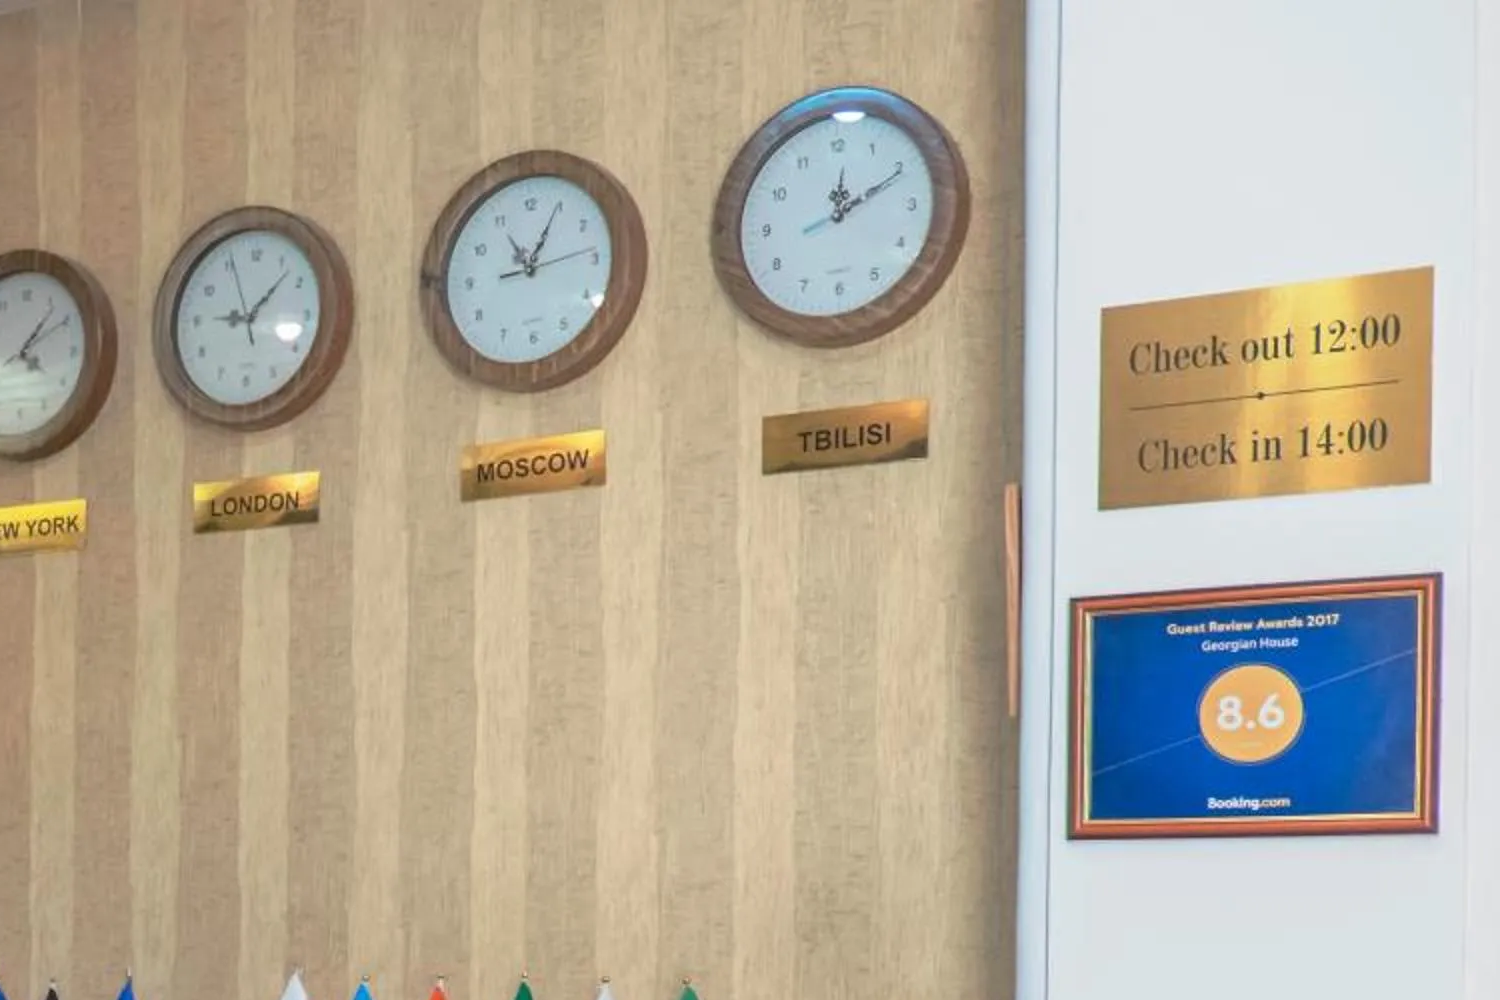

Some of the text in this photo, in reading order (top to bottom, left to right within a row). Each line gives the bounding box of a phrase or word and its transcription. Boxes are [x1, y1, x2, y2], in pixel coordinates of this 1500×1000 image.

[830, 138, 845, 153] 12
[797, 156, 809, 170] 11
[772, 187, 787, 201] 10
[869, 267, 880, 281] 5
[798, 279, 809, 293] 7
[1129, 312, 1401, 377] Check out 12:00
[797, 422, 892, 454] TBILISI
[1138, 417, 1388, 473] Check in 14:00
[476, 449, 589, 484] MOSCOW
[211, 491, 300, 517] LONDON
[25, 515, 80, 538] YORK
[1166, 613, 1340, 636] Guest Review Awards 2017
[1201, 636, 1299, 653] Georgian House
[1217, 693, 1285, 732] 8.6
[1207, 796, 1291, 811] Booking.com
